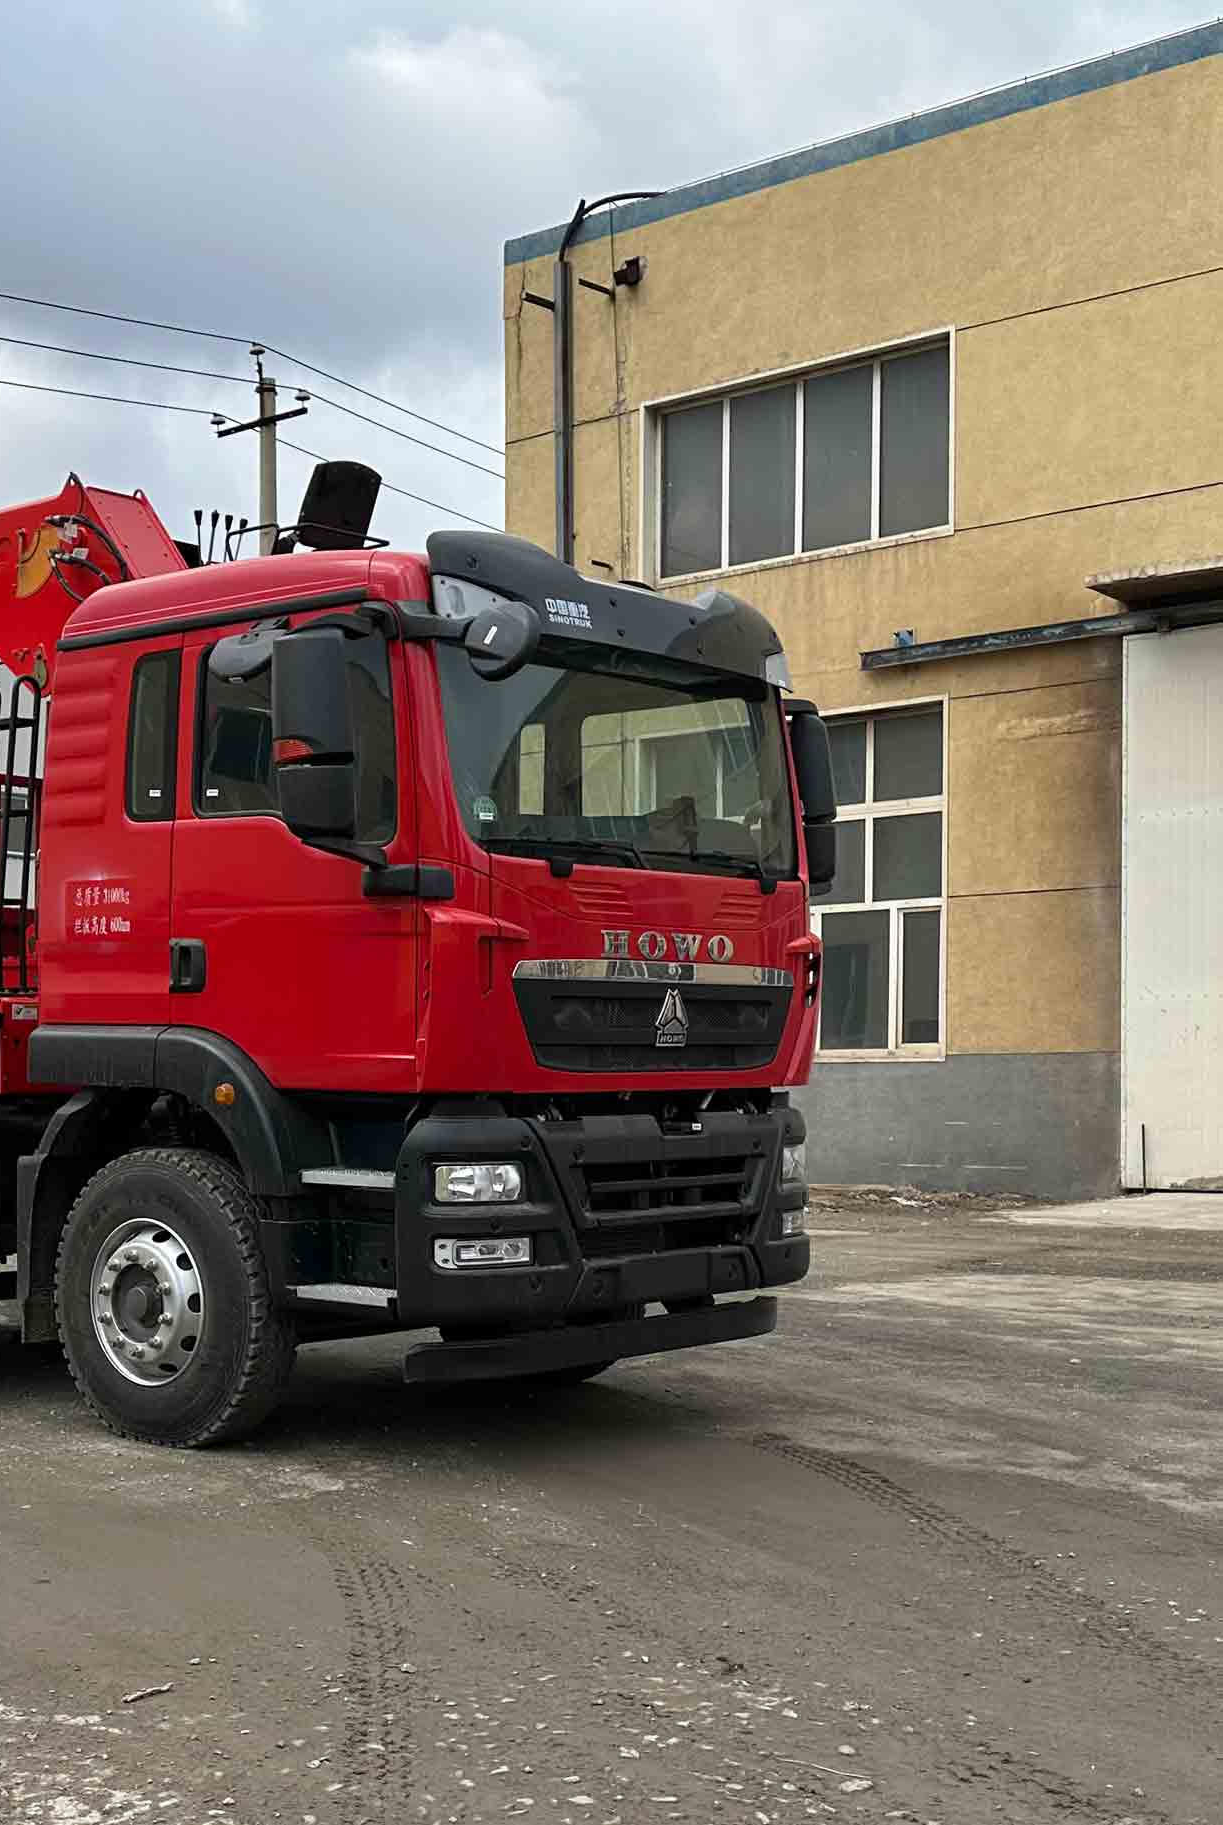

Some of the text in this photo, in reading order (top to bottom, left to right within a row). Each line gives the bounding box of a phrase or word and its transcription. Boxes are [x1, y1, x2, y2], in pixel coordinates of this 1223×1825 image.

[545, 599, 591, 619] 中国重汽
[548, 613, 593, 629] SINOTRUK
[601, 930, 734, 961] HOWO
